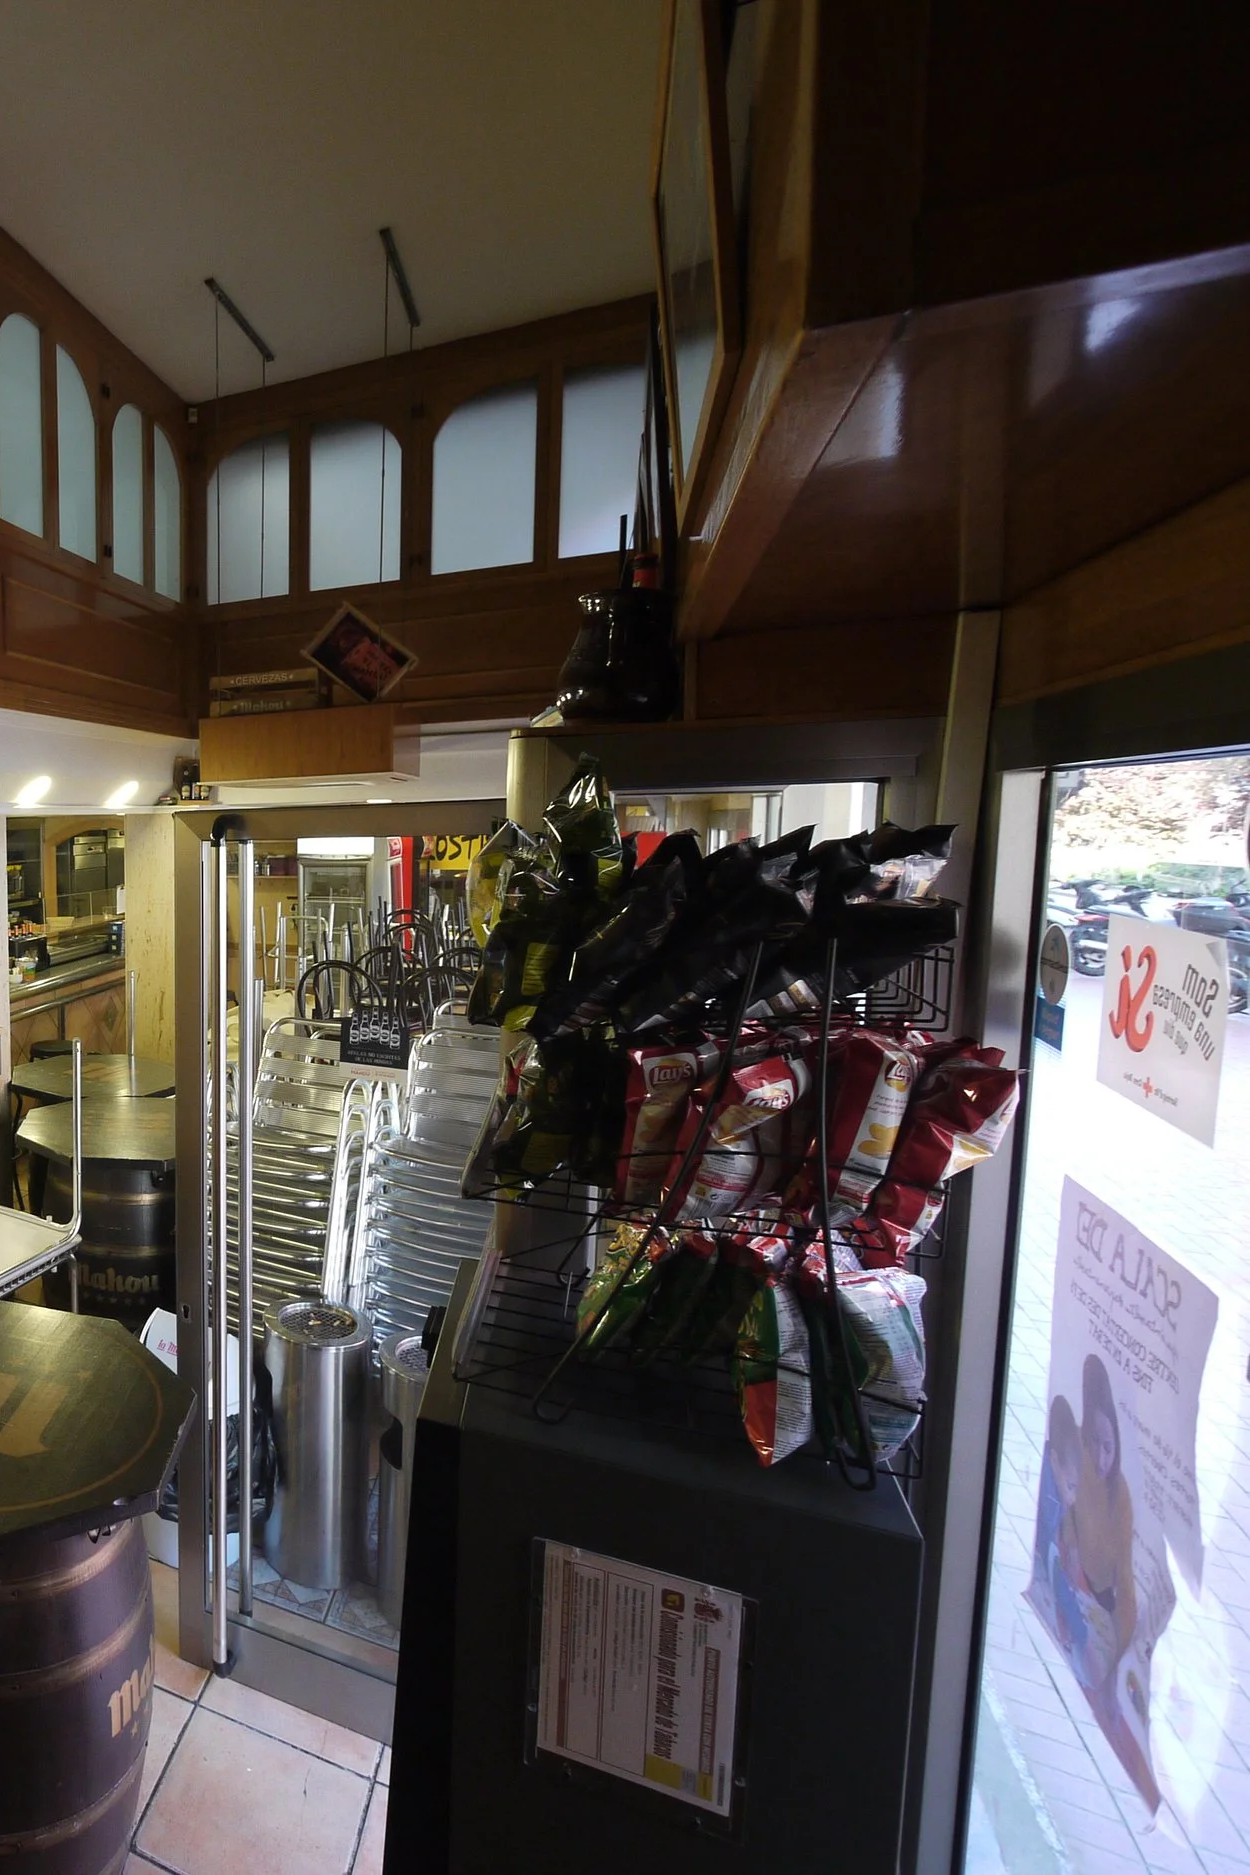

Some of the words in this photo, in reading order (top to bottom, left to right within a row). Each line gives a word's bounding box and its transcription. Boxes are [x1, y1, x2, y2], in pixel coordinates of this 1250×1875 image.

[235, 673, 288, 686] CERVEZAS
[653, 1064, 692, 1085] Lay's
[656, 1610, 684, 1660] Comisionado
[654, 1656, 679, 1679] para
[656, 1683, 682, 1717] Mercado
[656, 1715, 680, 1728] de
[654, 1727, 681, 1760] Tabacos
